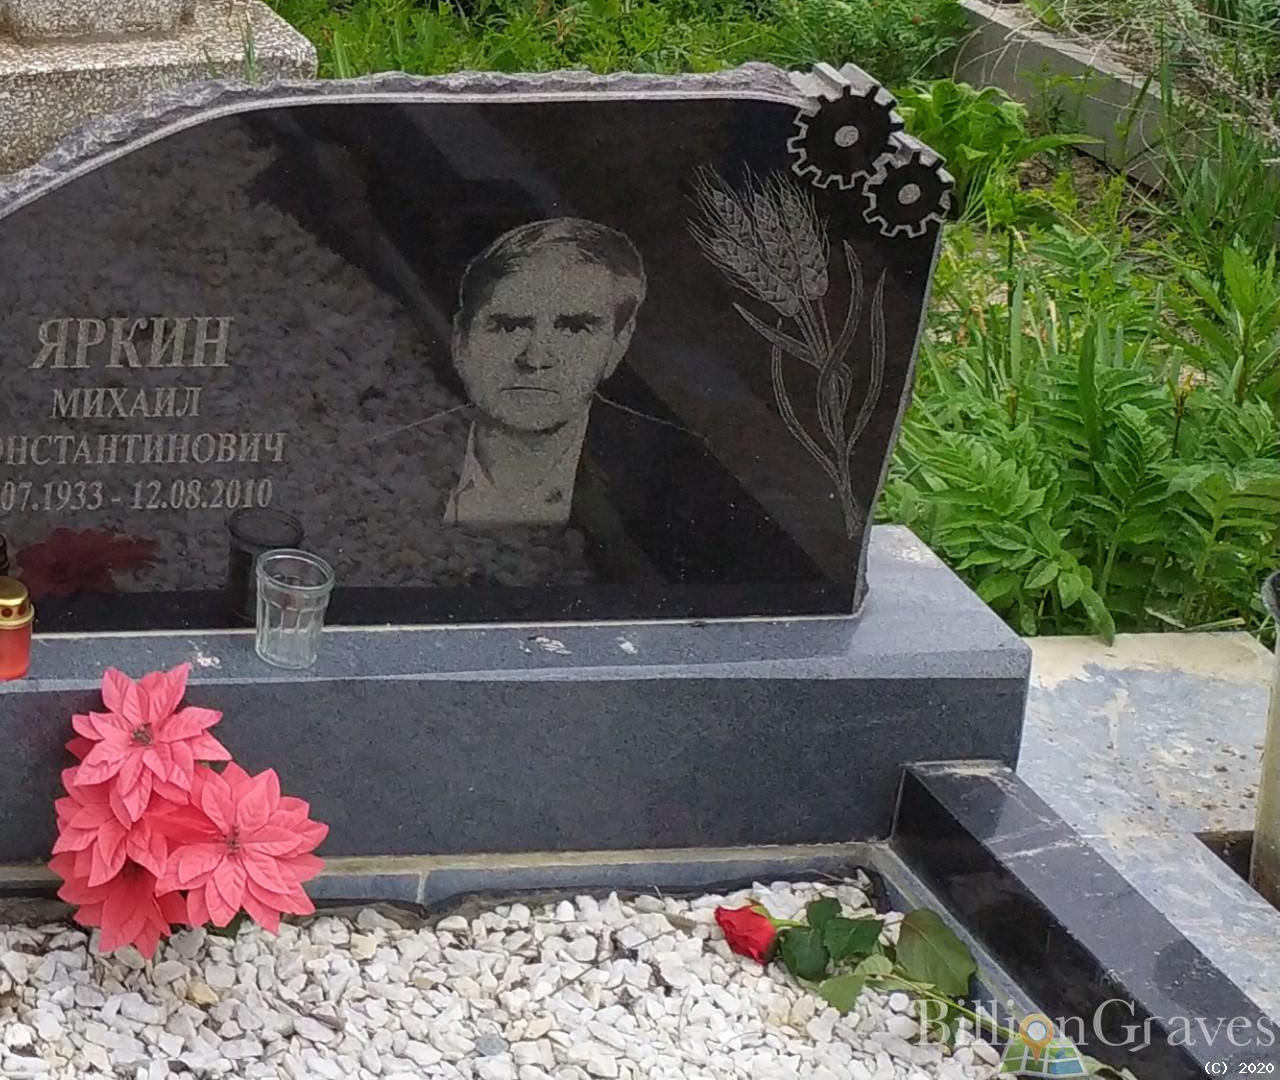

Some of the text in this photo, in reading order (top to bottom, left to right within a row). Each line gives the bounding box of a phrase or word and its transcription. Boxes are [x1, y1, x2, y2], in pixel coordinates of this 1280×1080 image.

[29, 316, 235, 369] ЯРКИН
[50, 386, 203, 419] МИХАИЛ
[129, 478, 274, 510] 12.08.2010
